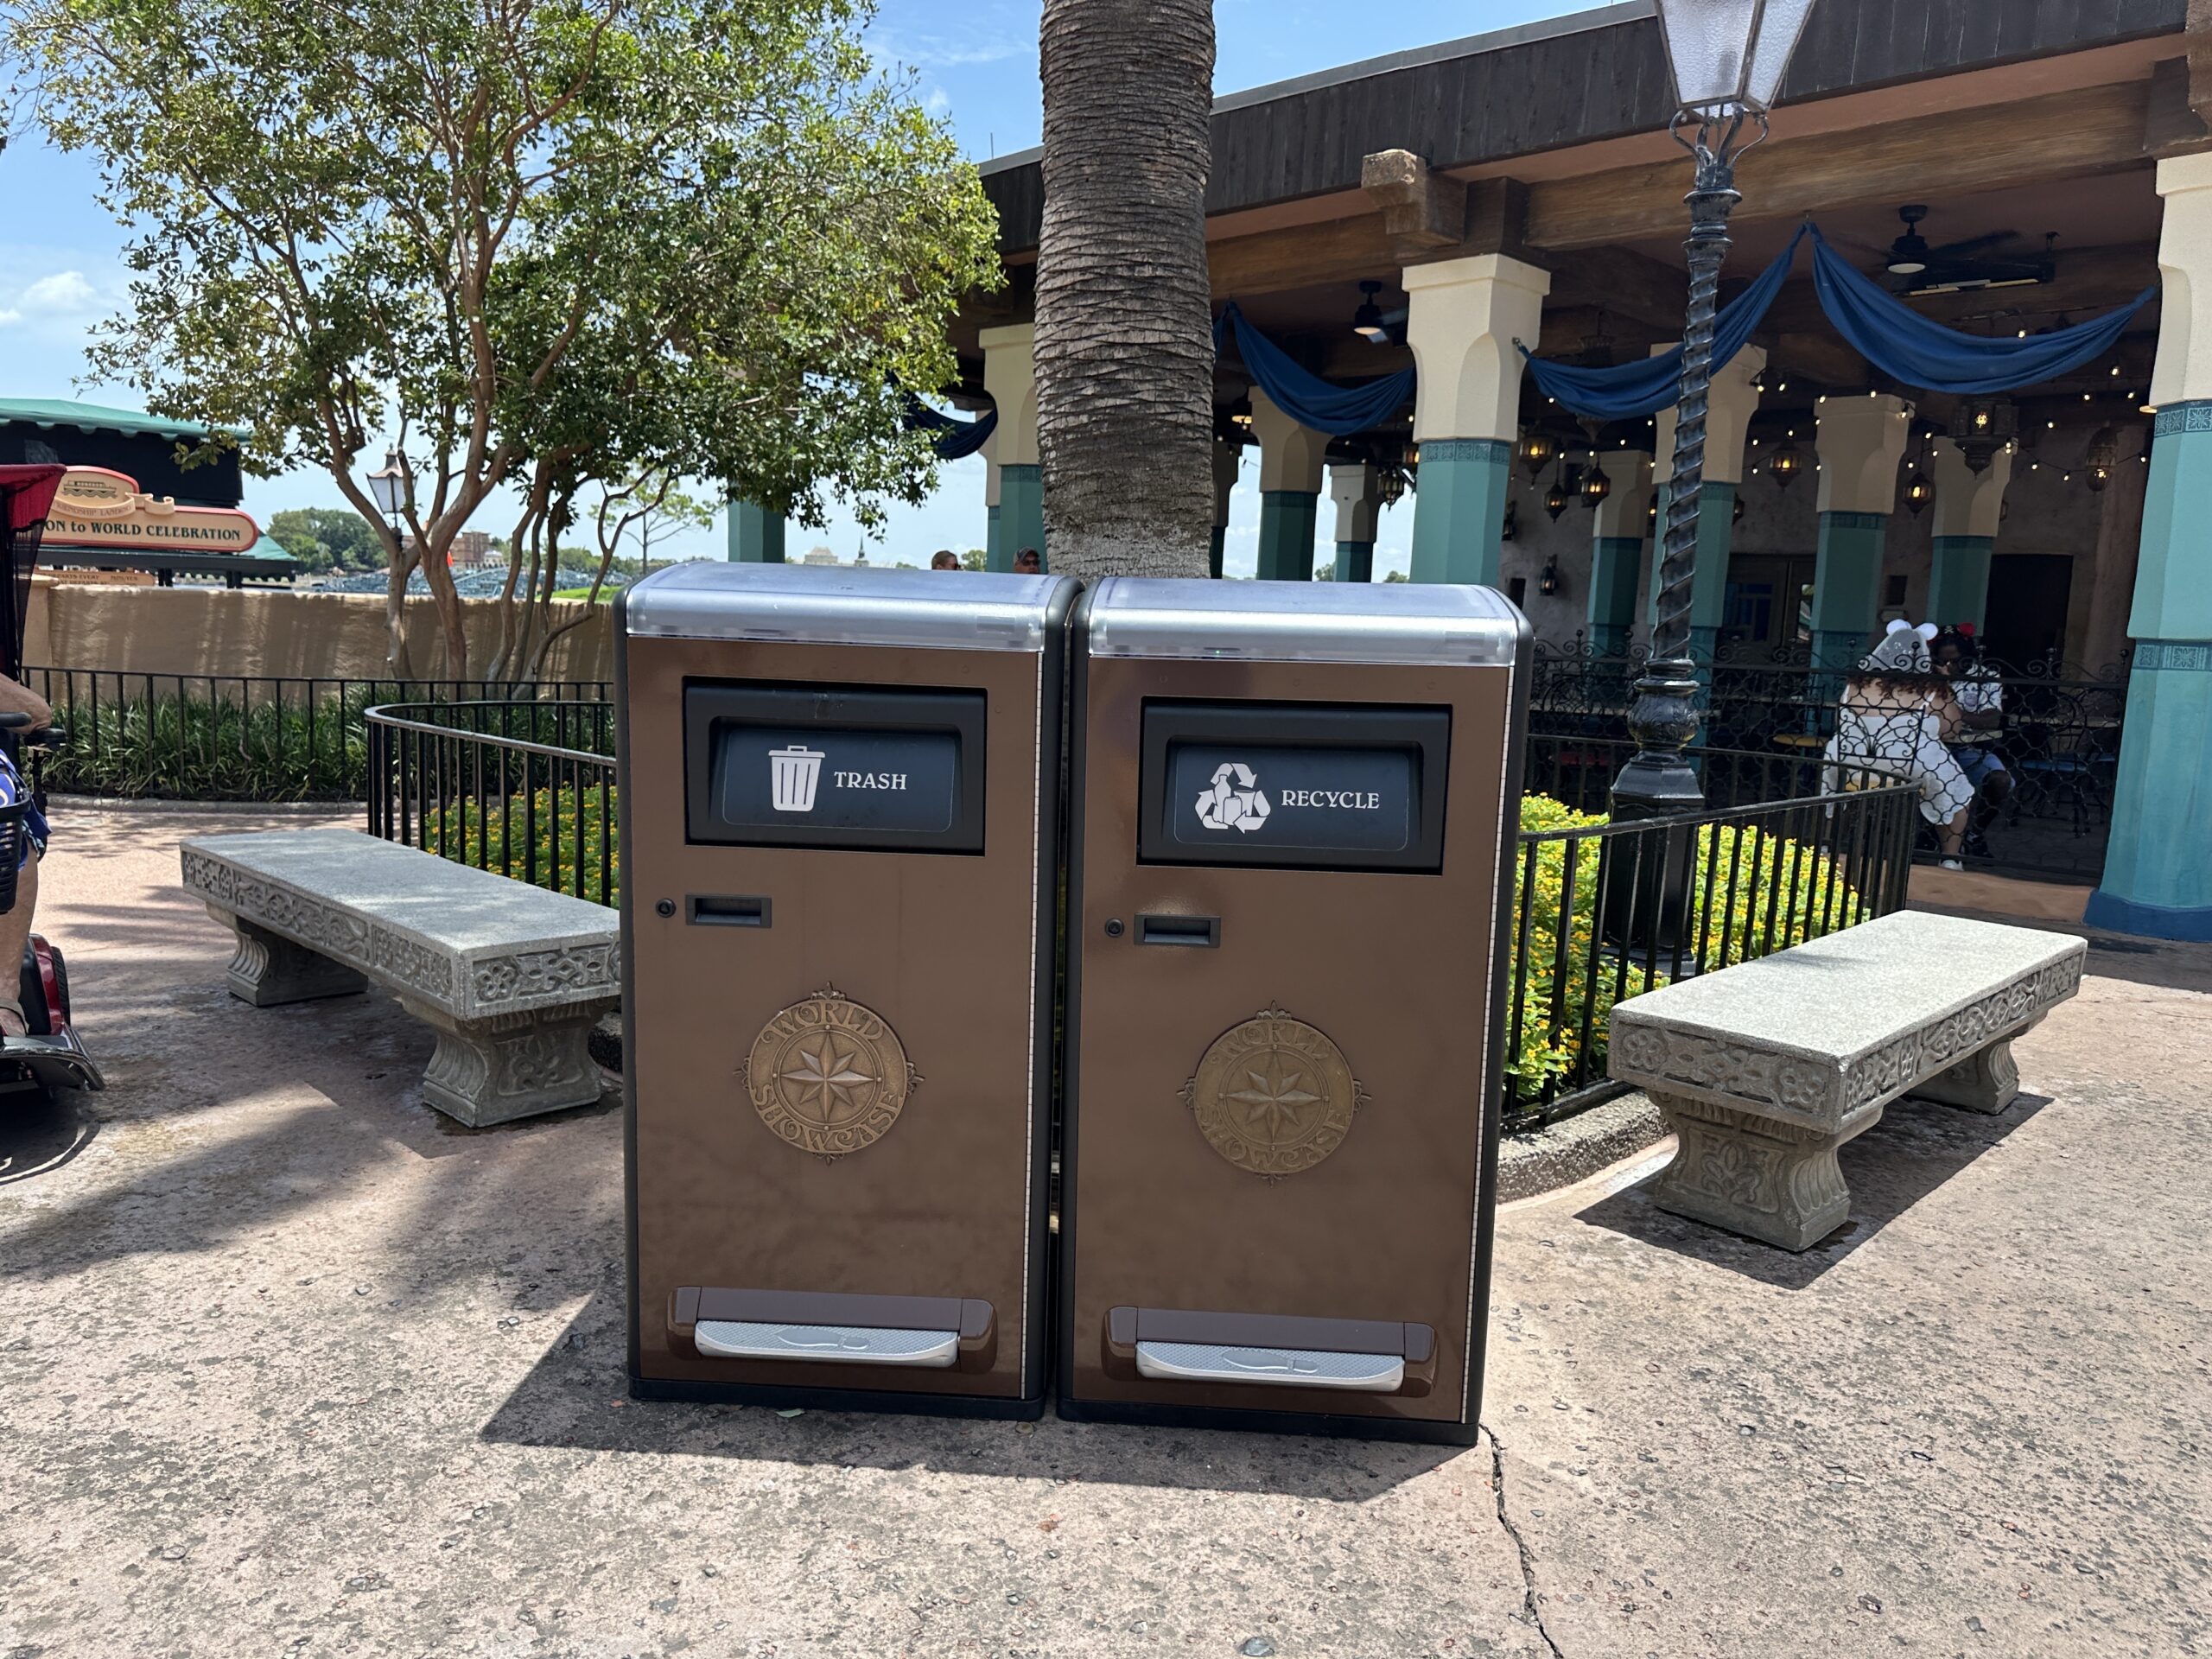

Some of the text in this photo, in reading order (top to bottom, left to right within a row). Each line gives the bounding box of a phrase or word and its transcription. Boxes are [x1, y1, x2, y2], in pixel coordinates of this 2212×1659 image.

[70, 520, 86, 533] to
[91, 521, 142, 536] WORLD
[146, 524, 241, 541] CELEBRATION
[834, 771, 907, 790] TRASH
[1281, 790, 1381, 810] RECYCLE
[760, 1001, 884, 1044] WORLD
[1209, 1020, 1332, 1065] WORLD
[752, 1084, 904, 1153] SHOWCASE
[1196, 1103, 1351, 1167] SHOWCASE
